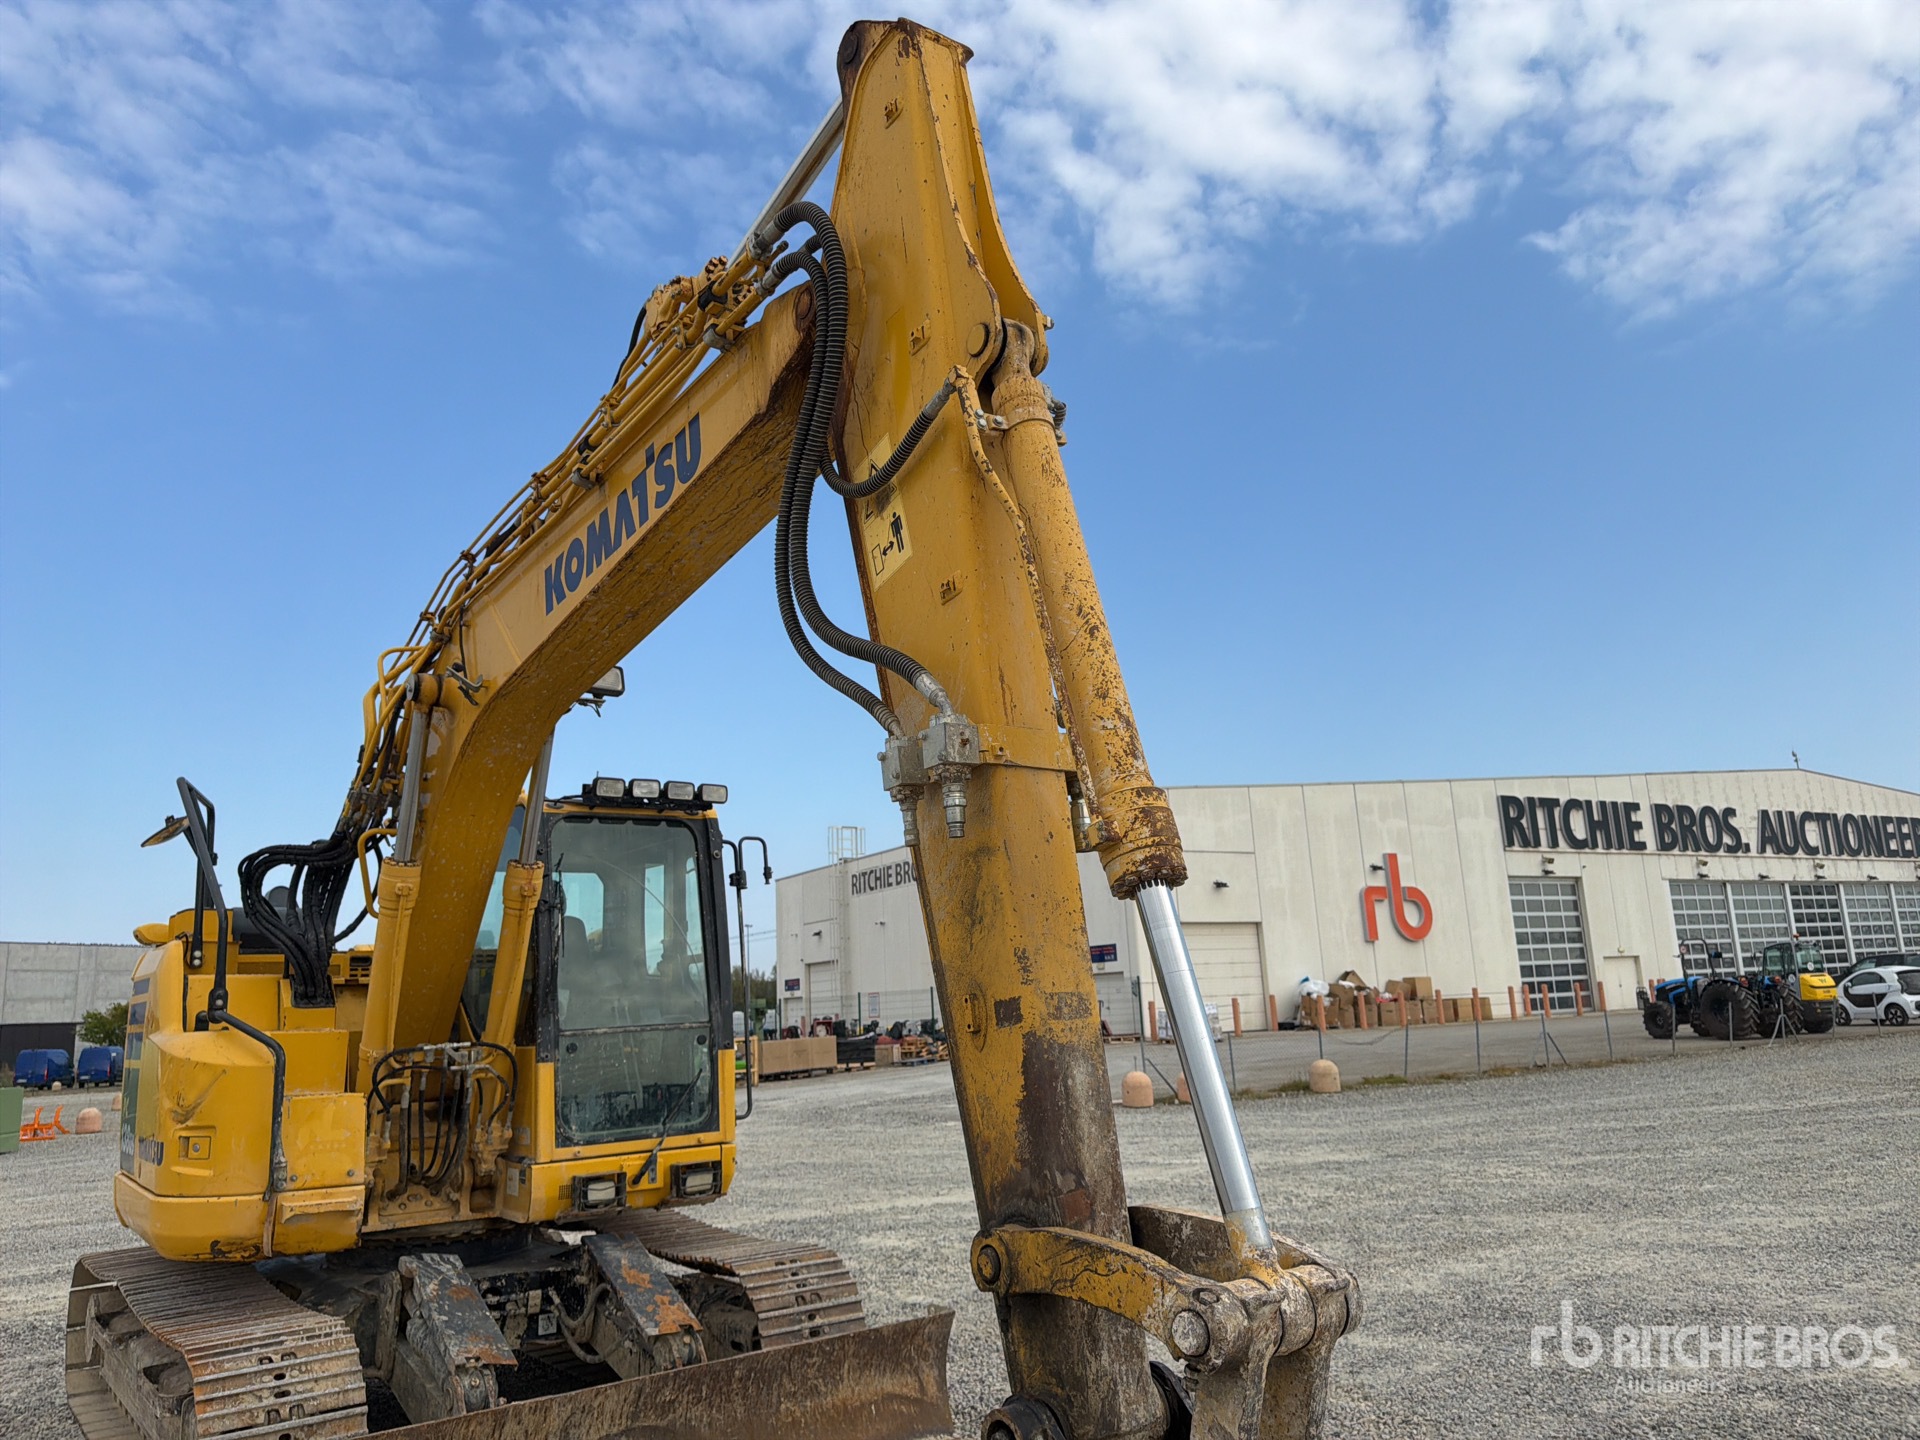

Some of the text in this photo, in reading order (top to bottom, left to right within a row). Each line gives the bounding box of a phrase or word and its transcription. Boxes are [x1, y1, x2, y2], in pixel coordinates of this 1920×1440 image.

[545, 412, 702, 617] KOMATSU
[1498, 795, 1647, 851] RITCHIE
[1651, 803, 1751, 854] BROS.
[851, 866, 893, 896] RITCHIE
